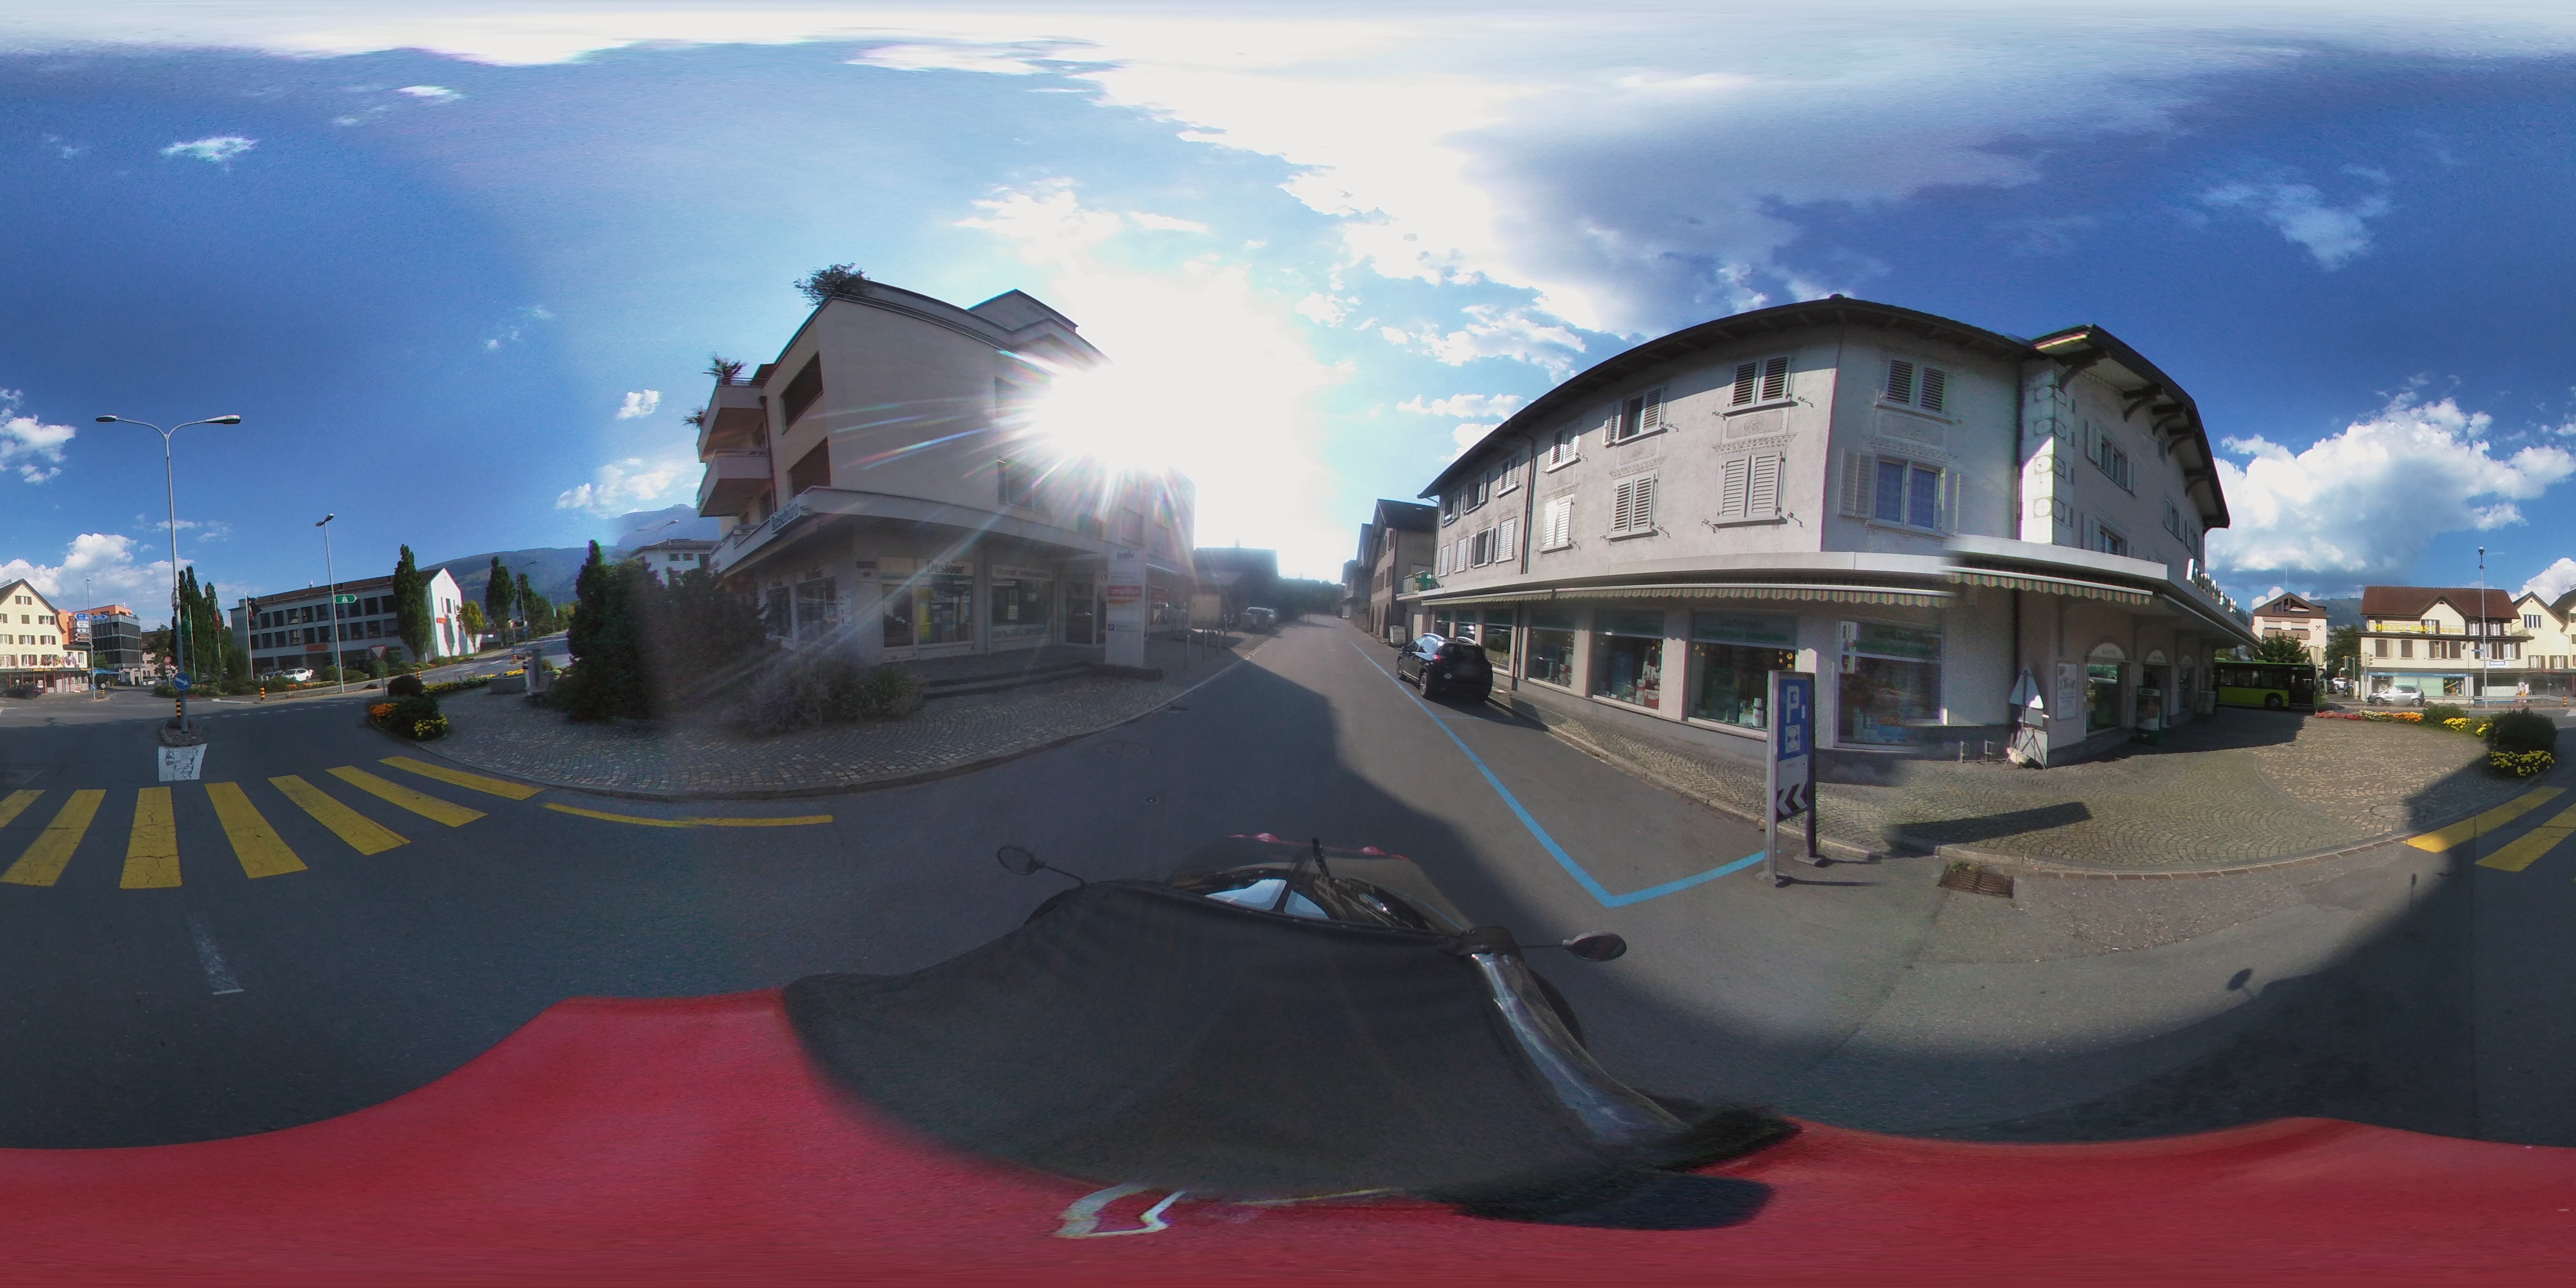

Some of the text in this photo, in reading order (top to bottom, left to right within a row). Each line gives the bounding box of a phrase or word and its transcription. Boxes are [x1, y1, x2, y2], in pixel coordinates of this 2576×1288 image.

[997, 568, 1050, 578] tourist information
[1110, 587, 1140, 596] amplifon
[2410, 624, 2436, 633] POST
[1786, 685, 1800, 723] P
